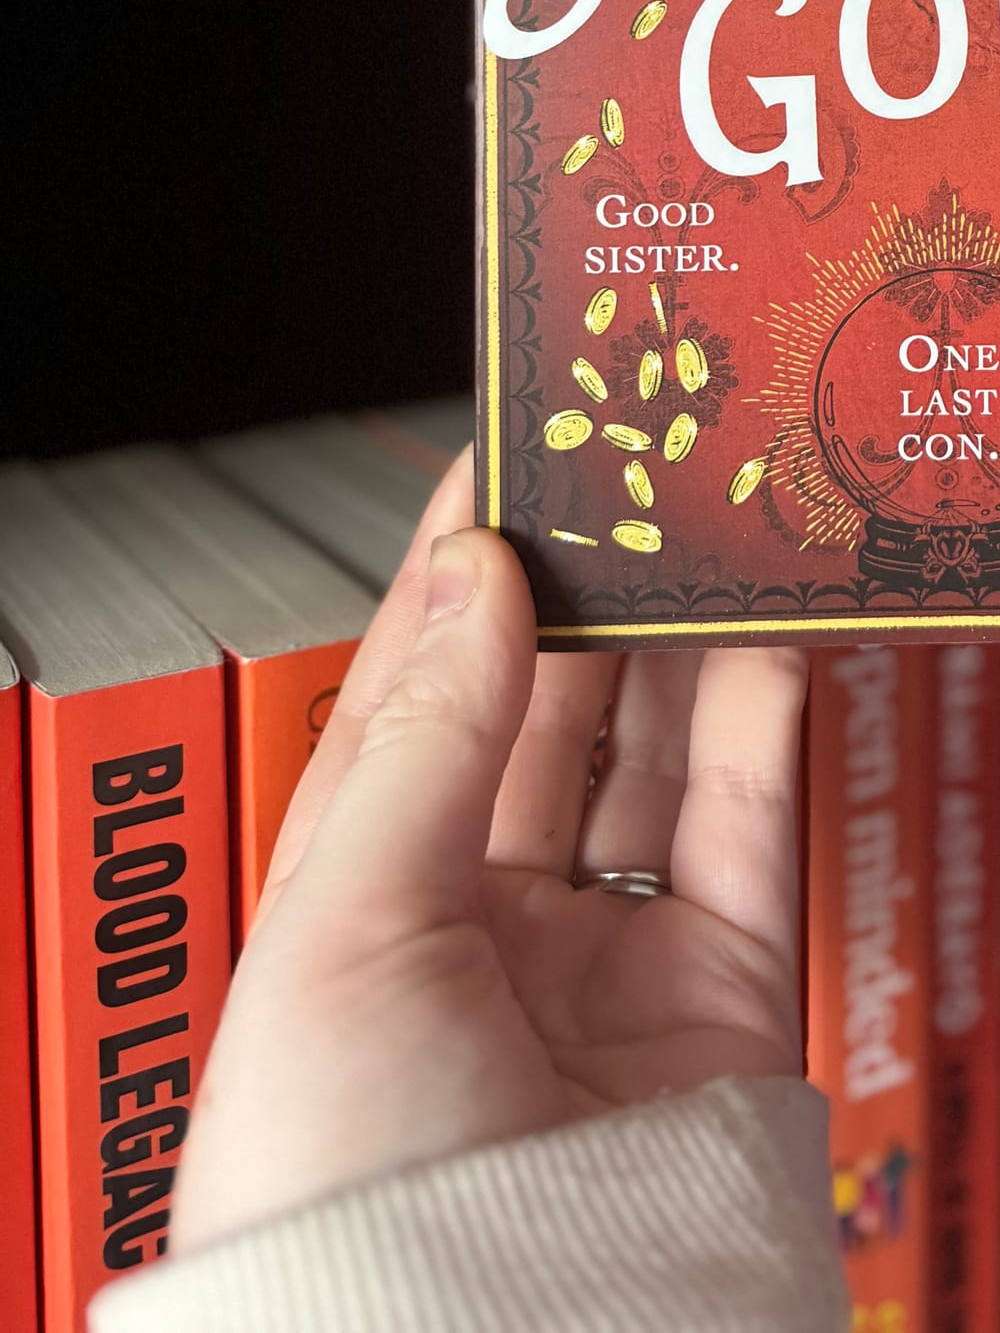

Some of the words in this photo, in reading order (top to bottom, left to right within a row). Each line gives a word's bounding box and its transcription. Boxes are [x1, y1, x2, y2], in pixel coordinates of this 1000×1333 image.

[595, 193, 716, 229] GOOD
[584, 237, 740, 273] SISTER.
[899, 335, 1000, 373] ONE
[899, 387, 998, 418] LAST
[898, 432, 999, 461] CON.
[92, 743, 189, 1009] BLOOD
